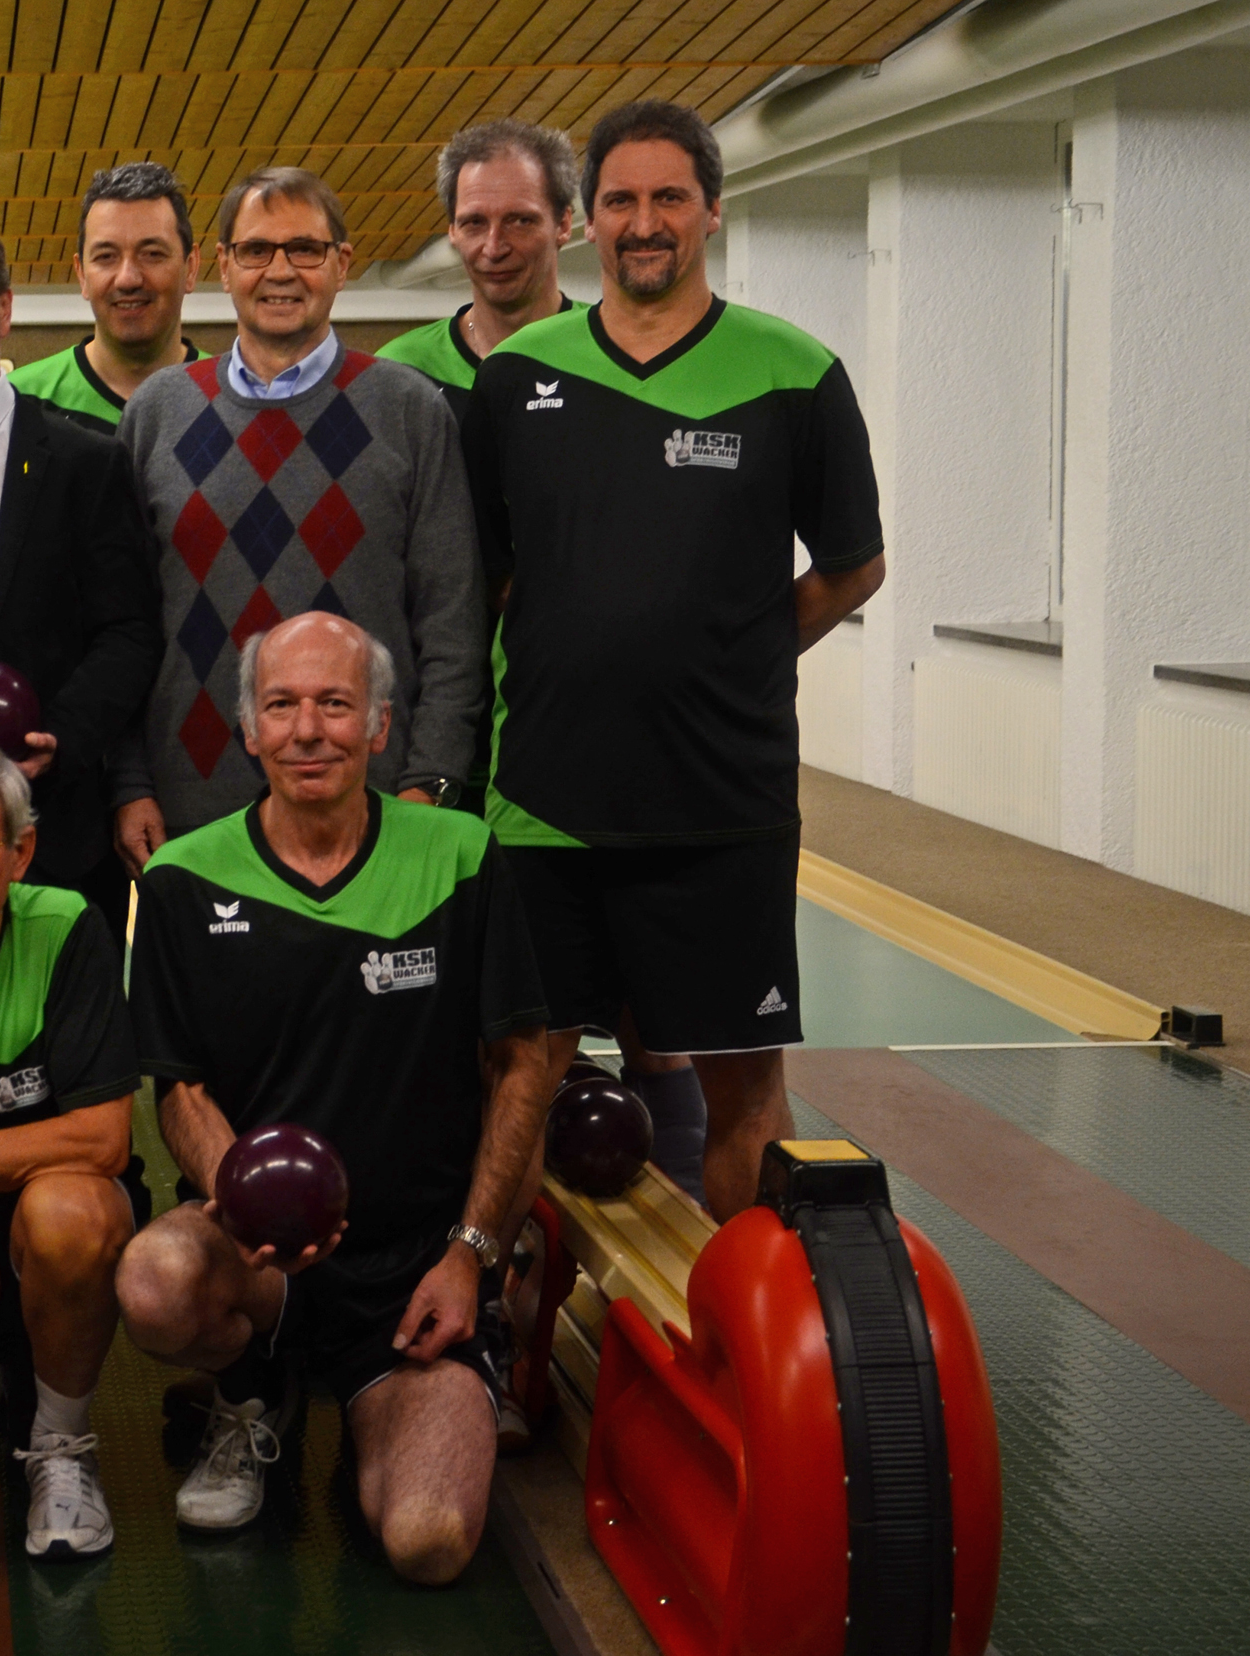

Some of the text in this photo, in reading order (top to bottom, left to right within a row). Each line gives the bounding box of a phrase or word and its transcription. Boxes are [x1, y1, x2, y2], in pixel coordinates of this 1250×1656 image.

[526, 397, 564, 411] erima
[693, 433, 739, 450] KSK
[209, 918, 250, 934] erima
[392, 949, 434, 969] KSK
